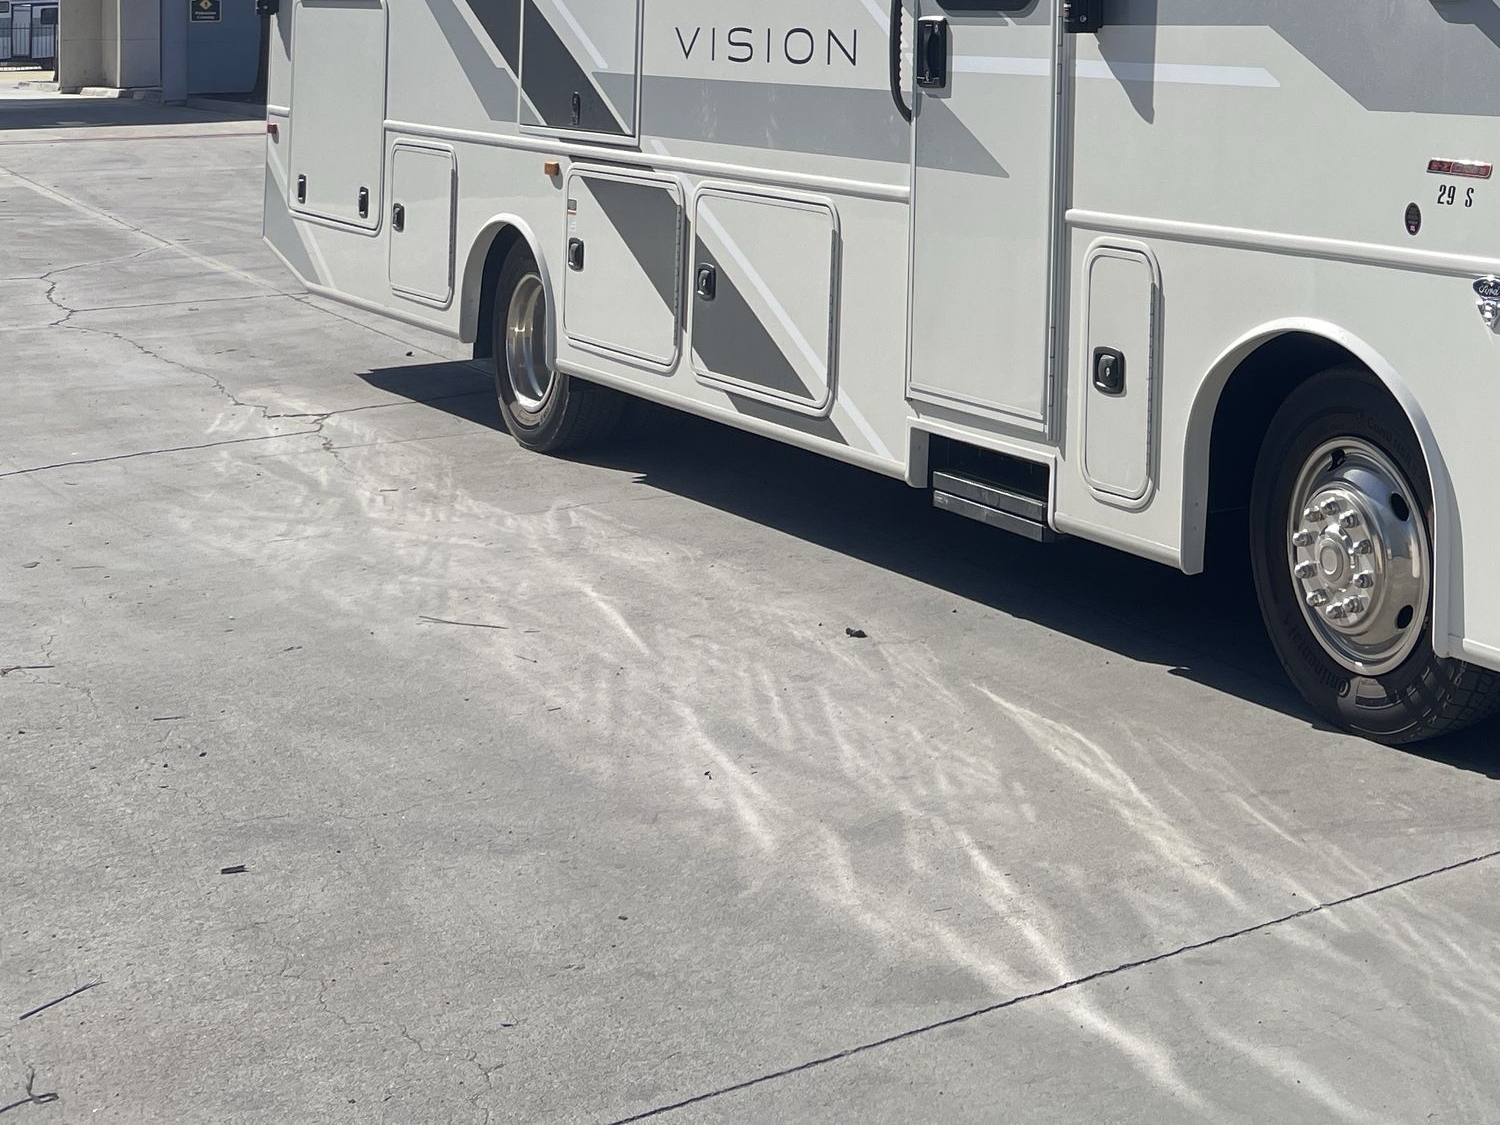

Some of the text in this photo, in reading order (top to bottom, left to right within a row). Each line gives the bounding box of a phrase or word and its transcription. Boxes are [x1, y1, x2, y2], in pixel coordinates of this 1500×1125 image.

[675, 27, 857, 66] VISION
[1437, 185, 1474, 207] 29 S
[1478, 282, 1500, 296] Ford
